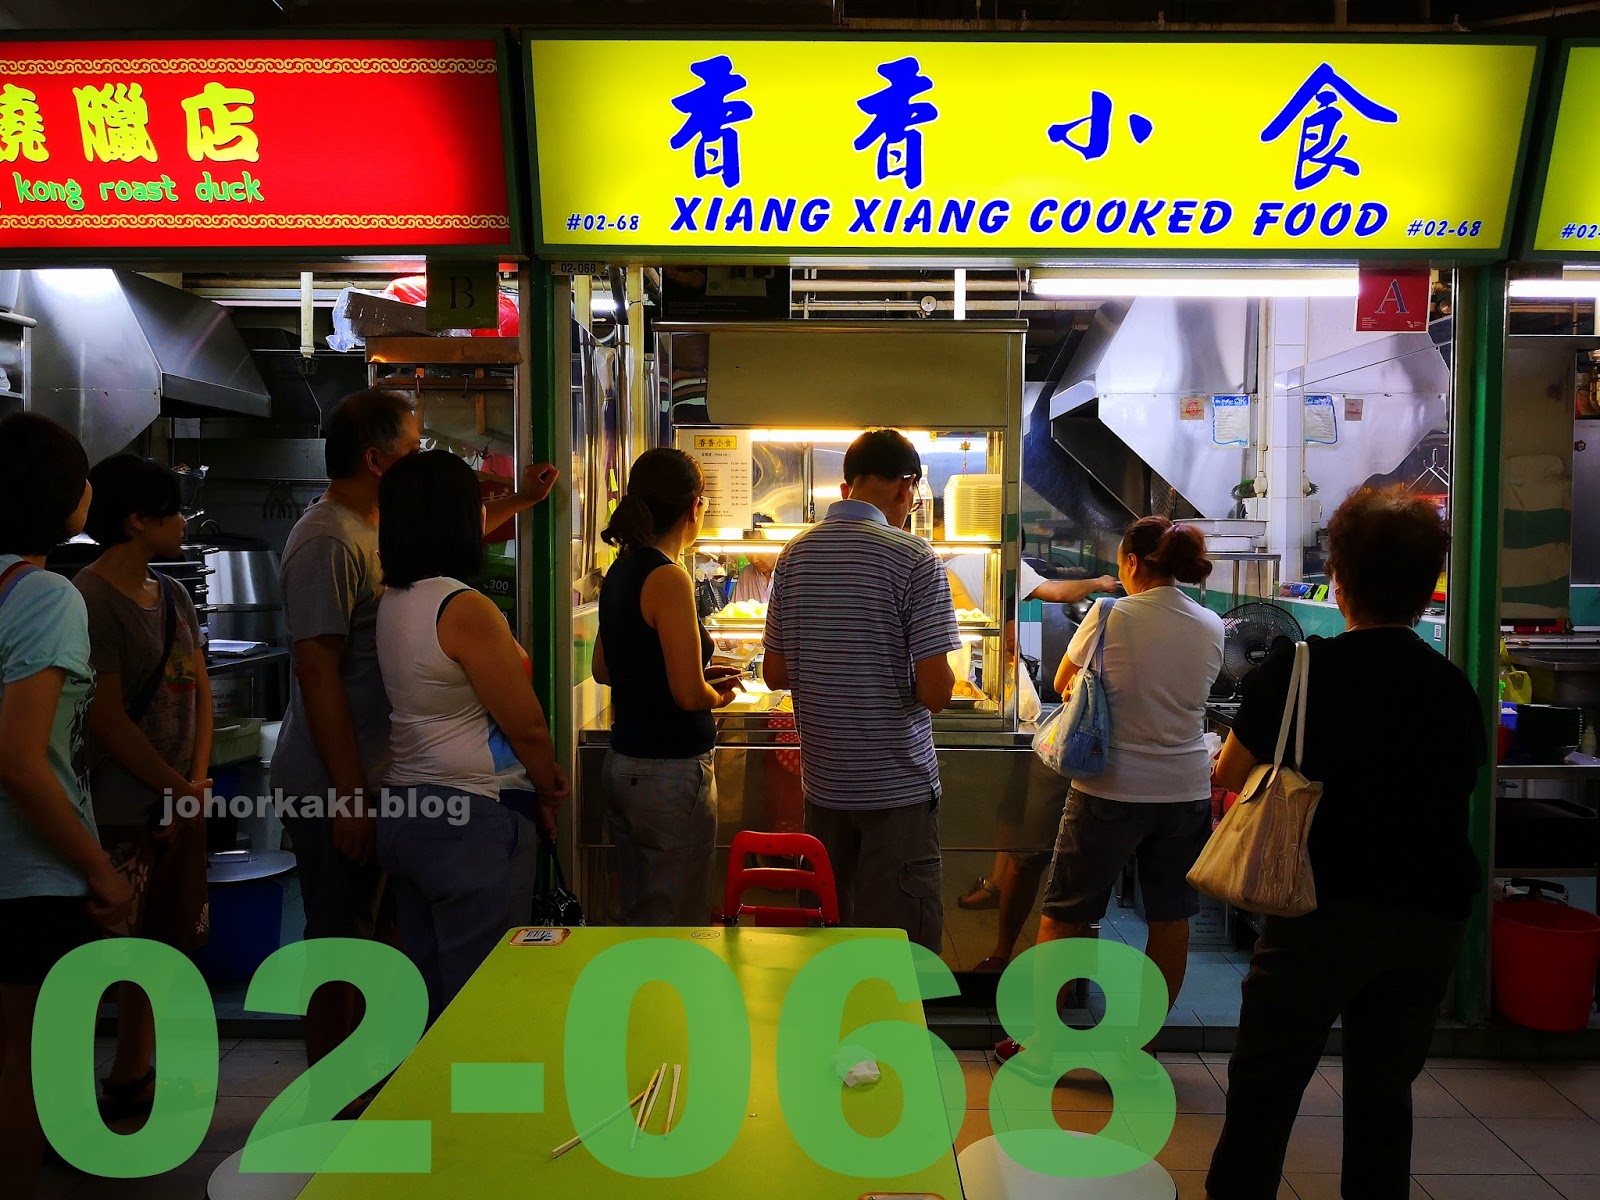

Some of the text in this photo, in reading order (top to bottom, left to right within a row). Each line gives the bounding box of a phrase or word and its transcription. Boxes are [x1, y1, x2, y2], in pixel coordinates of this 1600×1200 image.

[670, 55, 1398, 191] 香香小食
[12, 171, 265, 210] kong roast duck
[567, 214, 640, 231] #02-68
[670, 196, 1389, 237] XIANG XIANG COOKED FOOD
[1407, 220, 1482, 237] #02-68
[560, 263, 596, 273] 02-068
[449, 276, 476, 309] B
[1375, 279, 1410, 314] A
[489, 579, 509, 591] 300
